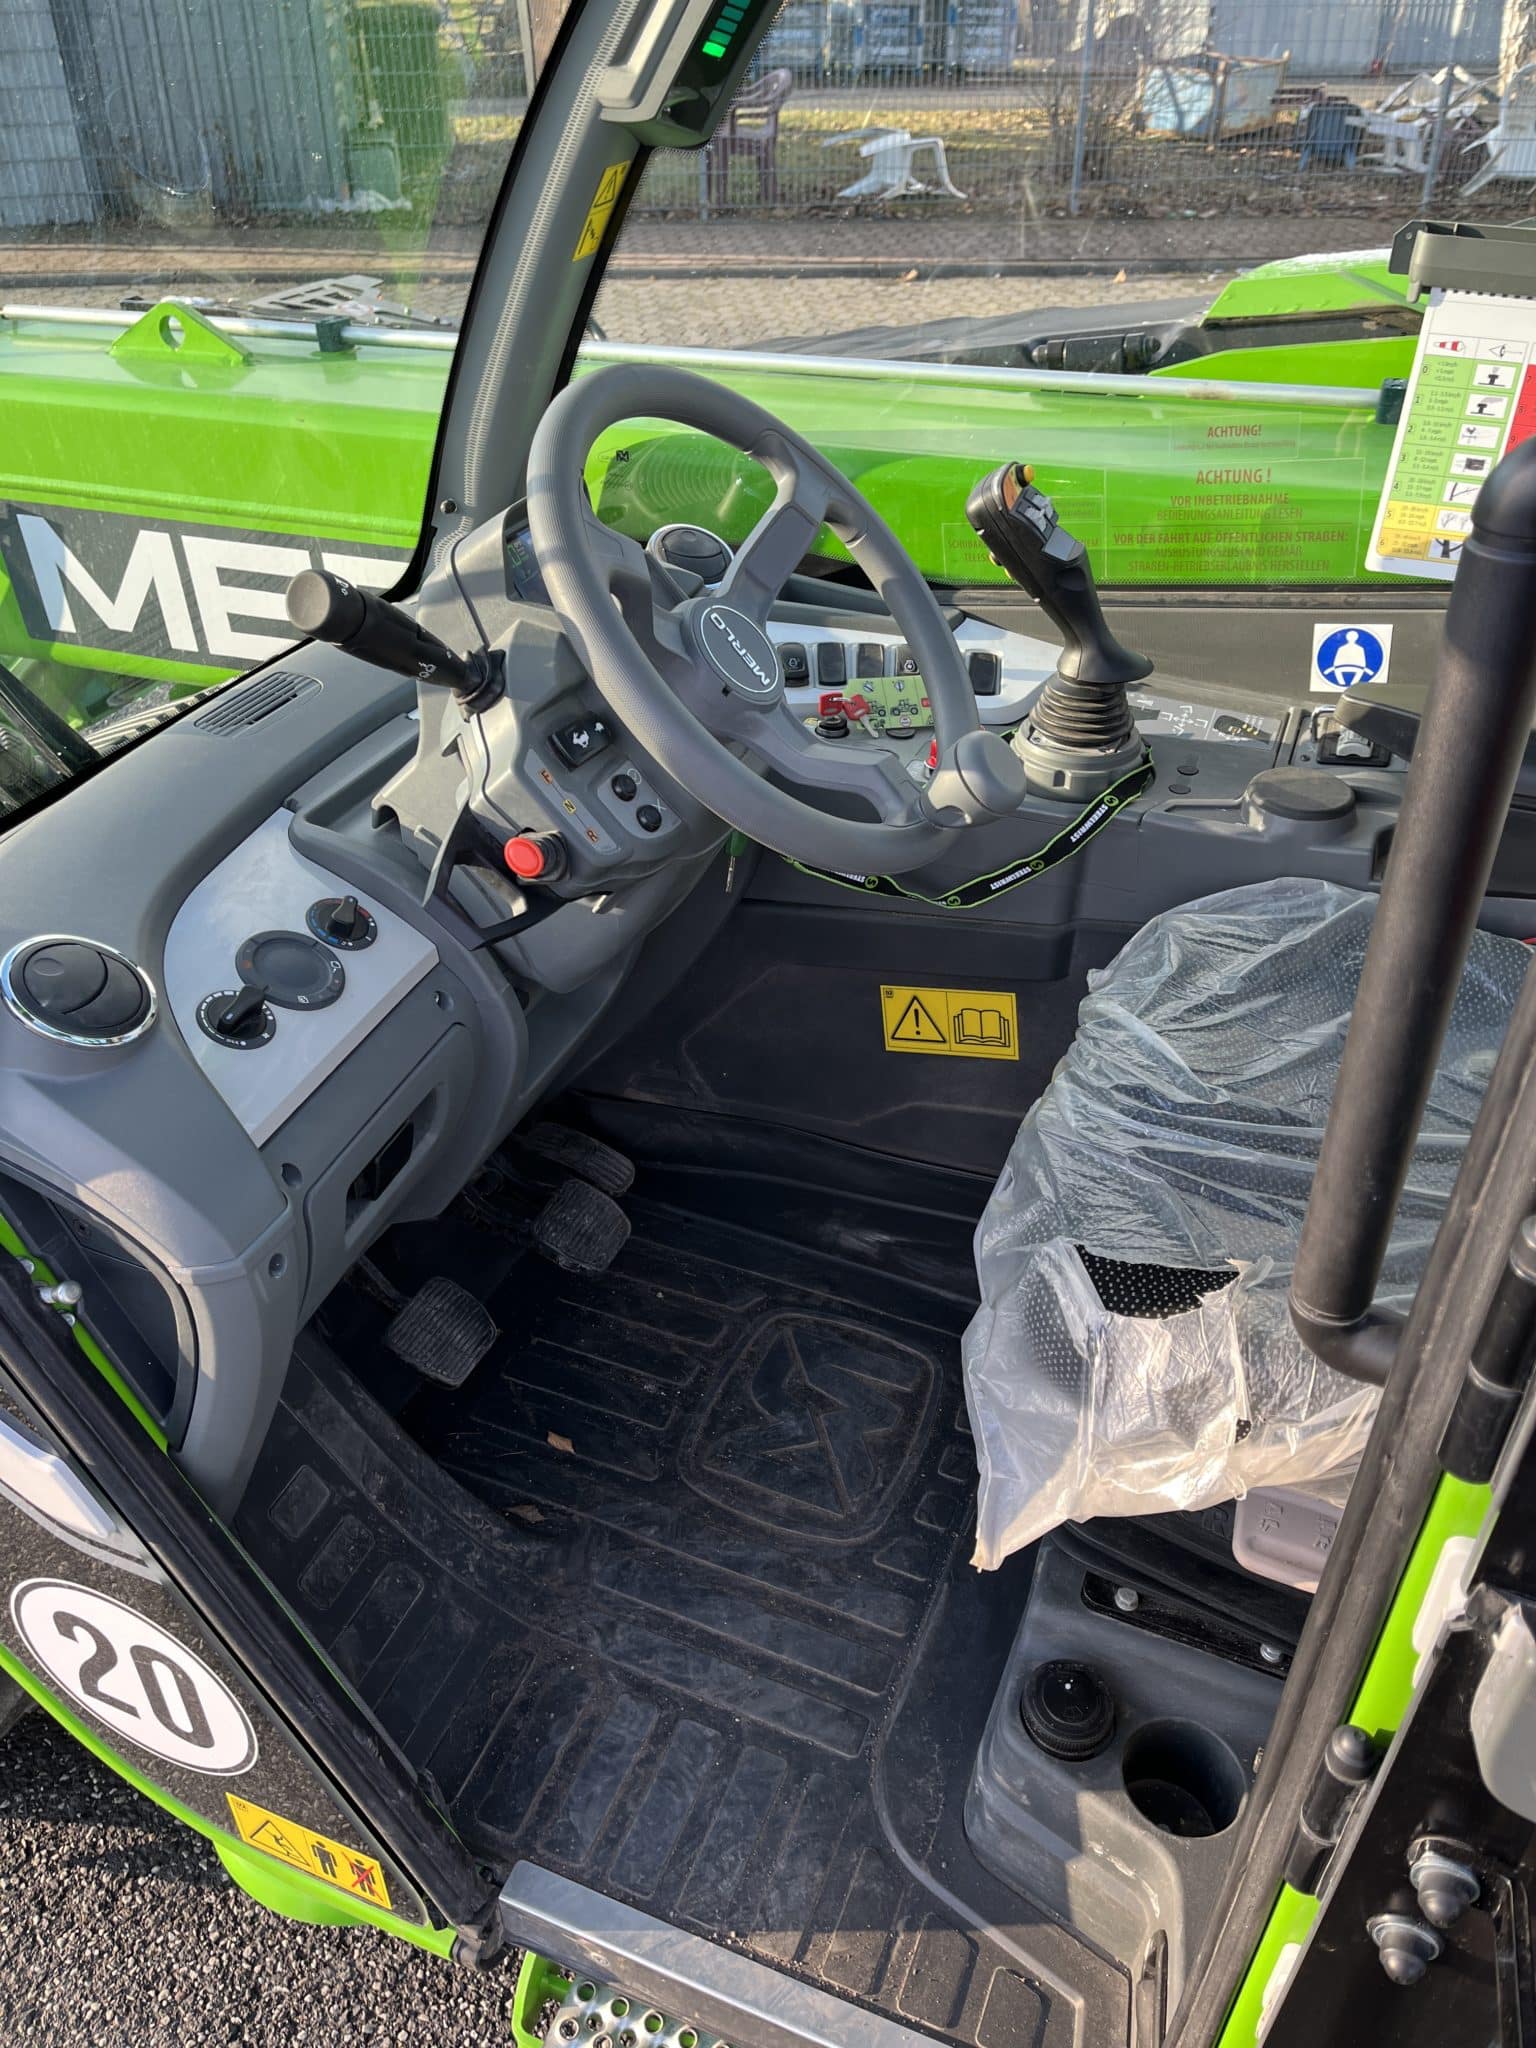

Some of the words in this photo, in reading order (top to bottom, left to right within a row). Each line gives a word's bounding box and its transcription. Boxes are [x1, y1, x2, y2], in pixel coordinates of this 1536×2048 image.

[1208, 424, 1262, 438] ACHTUNG!
[1170, 495, 1190, 507] VOR
[1193, 493, 1289, 506] INBETRIEBNAHME
[1113, 534, 1133, 545] VOR
[1136, 533, 1155, 545] DER
[1158, 533, 1190, 545] FAHRT
[1193, 533, 1212, 544] AUF
[710, 612, 771, 686] MERLO
[1070, 804, 1109, 843] STEELWRIST
[52, 1610, 214, 1749] 20
